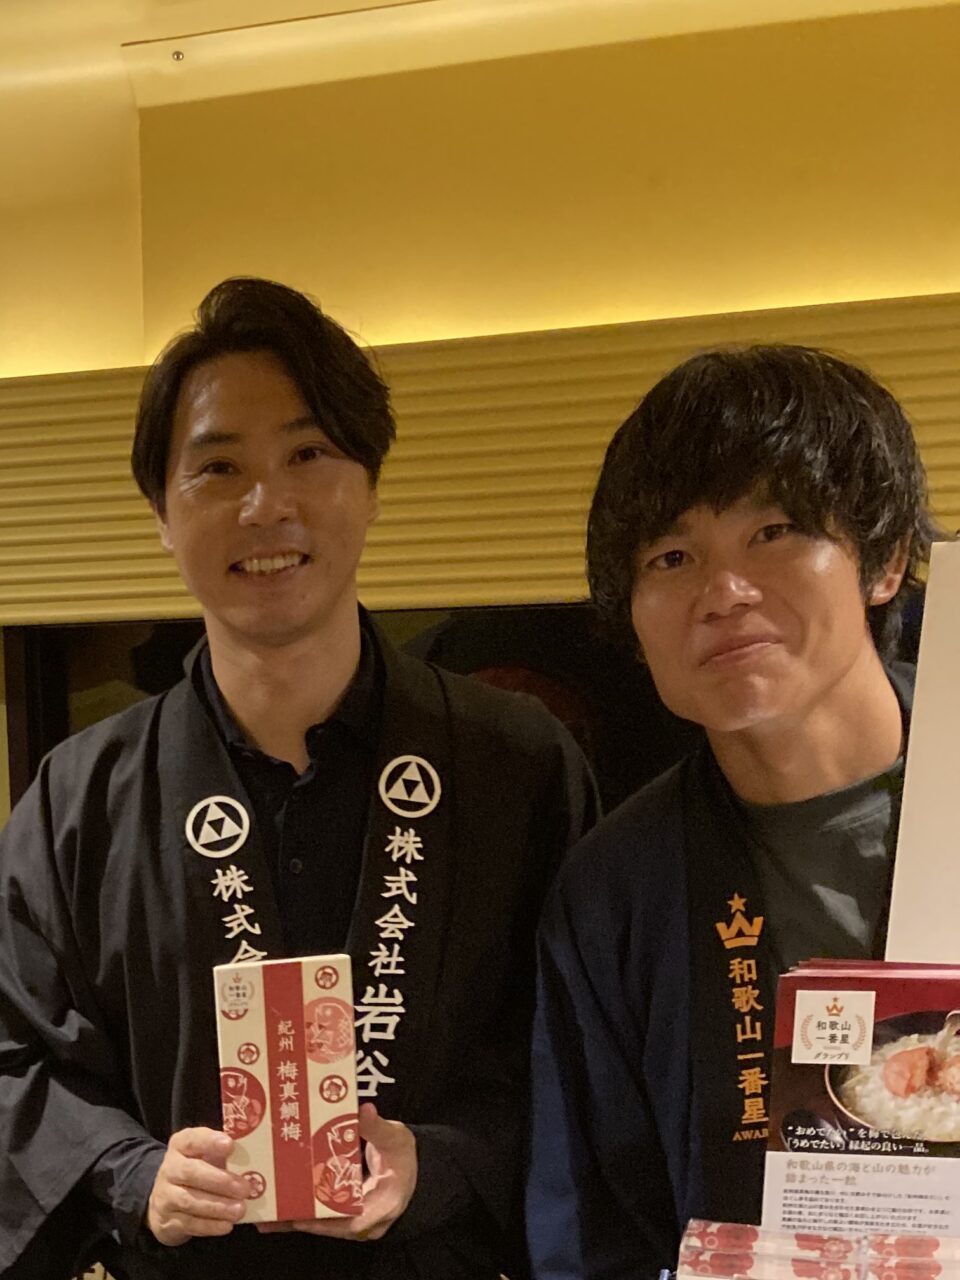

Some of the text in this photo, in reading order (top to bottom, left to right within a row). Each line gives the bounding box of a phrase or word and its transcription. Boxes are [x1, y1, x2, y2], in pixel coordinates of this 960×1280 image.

[277, 1020, 296, 1052] 紀州
[816, 1020, 851, 1031] 和歌山
[728, 957, 769, 1125] 和歌山一番星
[815, 1033, 850, 1044] 一番星
